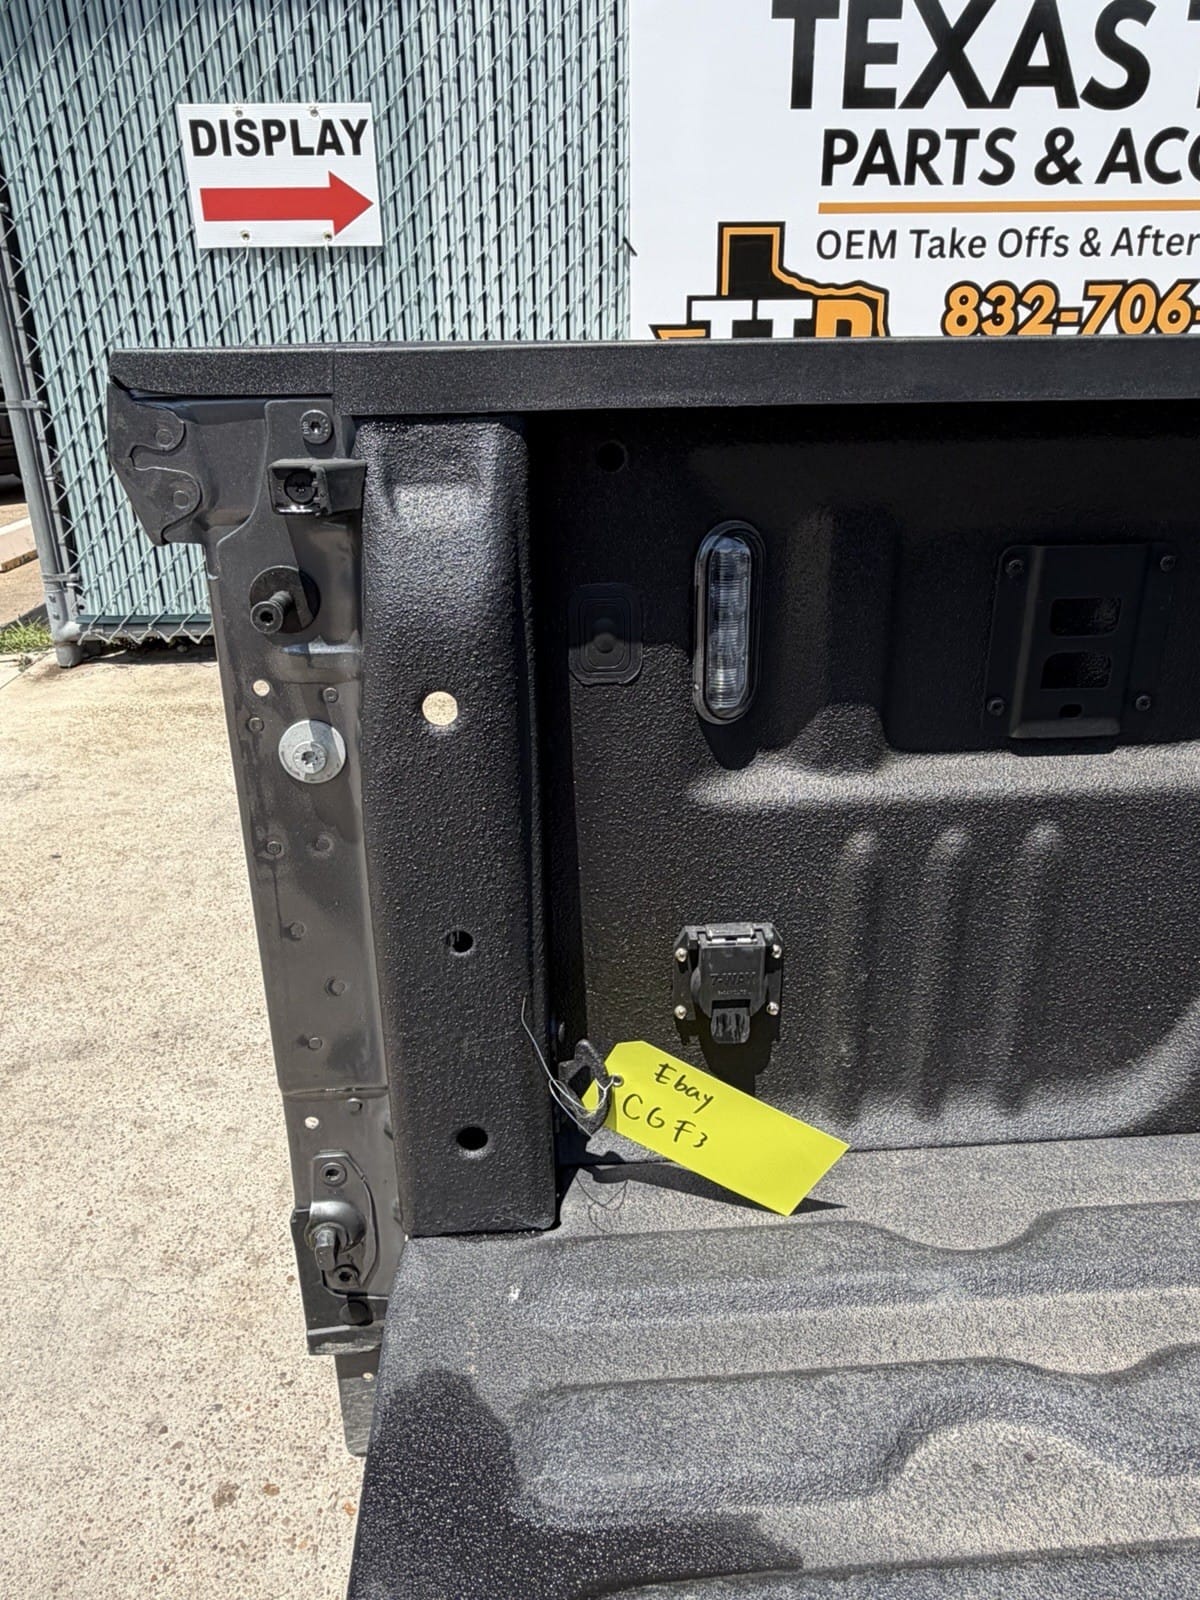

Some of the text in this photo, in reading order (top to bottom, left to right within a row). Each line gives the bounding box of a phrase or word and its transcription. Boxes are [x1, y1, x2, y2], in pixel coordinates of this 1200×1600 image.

[772, 0, 1157, 111] TEXAS
[188, 118, 369, 157] DISPLAY
[820, 127, 1018, 187] PARTS
[1034, 126, 1084, 186] &
[815, 224, 1200, 260] OEM Take Offs & After
[653, 1062, 714, 1115] Ebay
